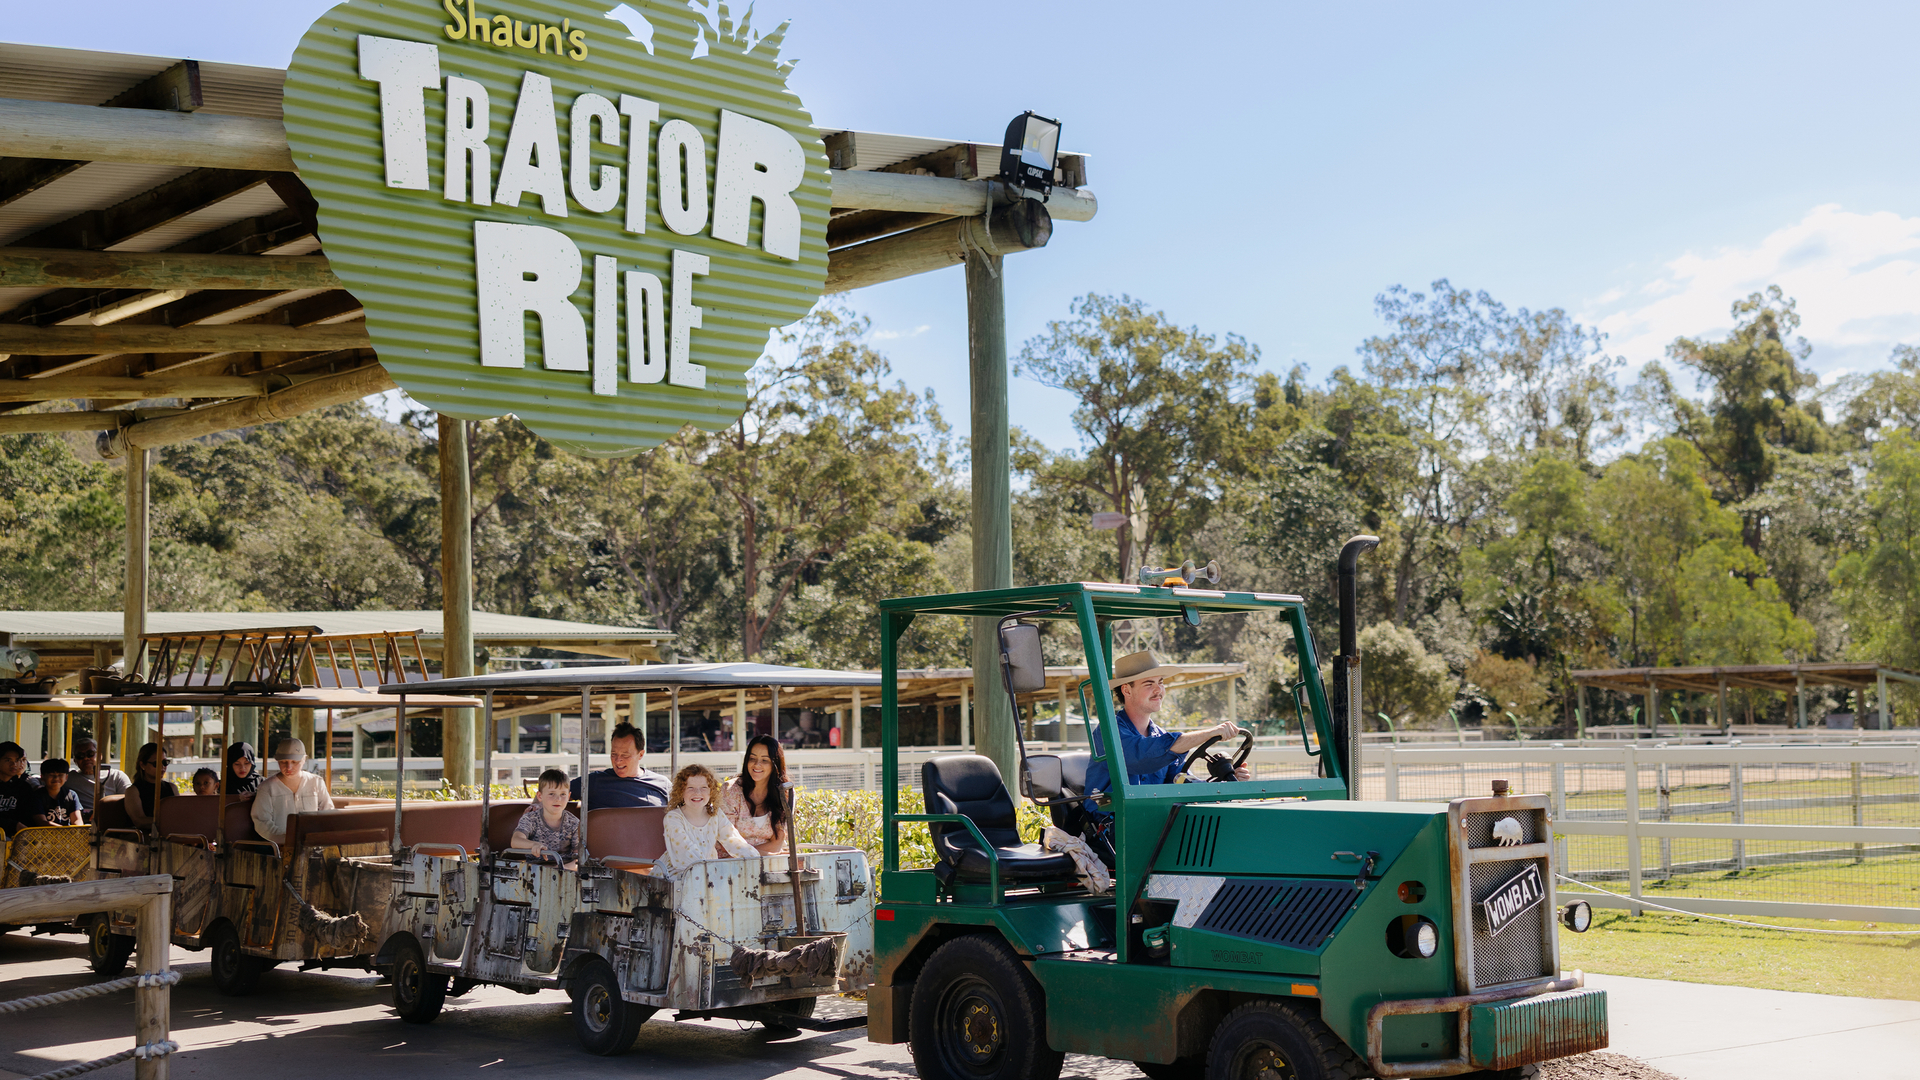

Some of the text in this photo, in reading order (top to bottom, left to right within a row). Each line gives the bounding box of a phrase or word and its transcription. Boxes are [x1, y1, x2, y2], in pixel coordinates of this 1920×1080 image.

[443, 0, 588, 62] Shaun's
[357, 34, 806, 261] TRACTOR
[473, 220, 710, 396] RIDE
[288, 902, 300, 927] WAY
[1488, 872, 1539, 928] WOMBAT
[1210, 949, 1263, 965] WOMBAT
